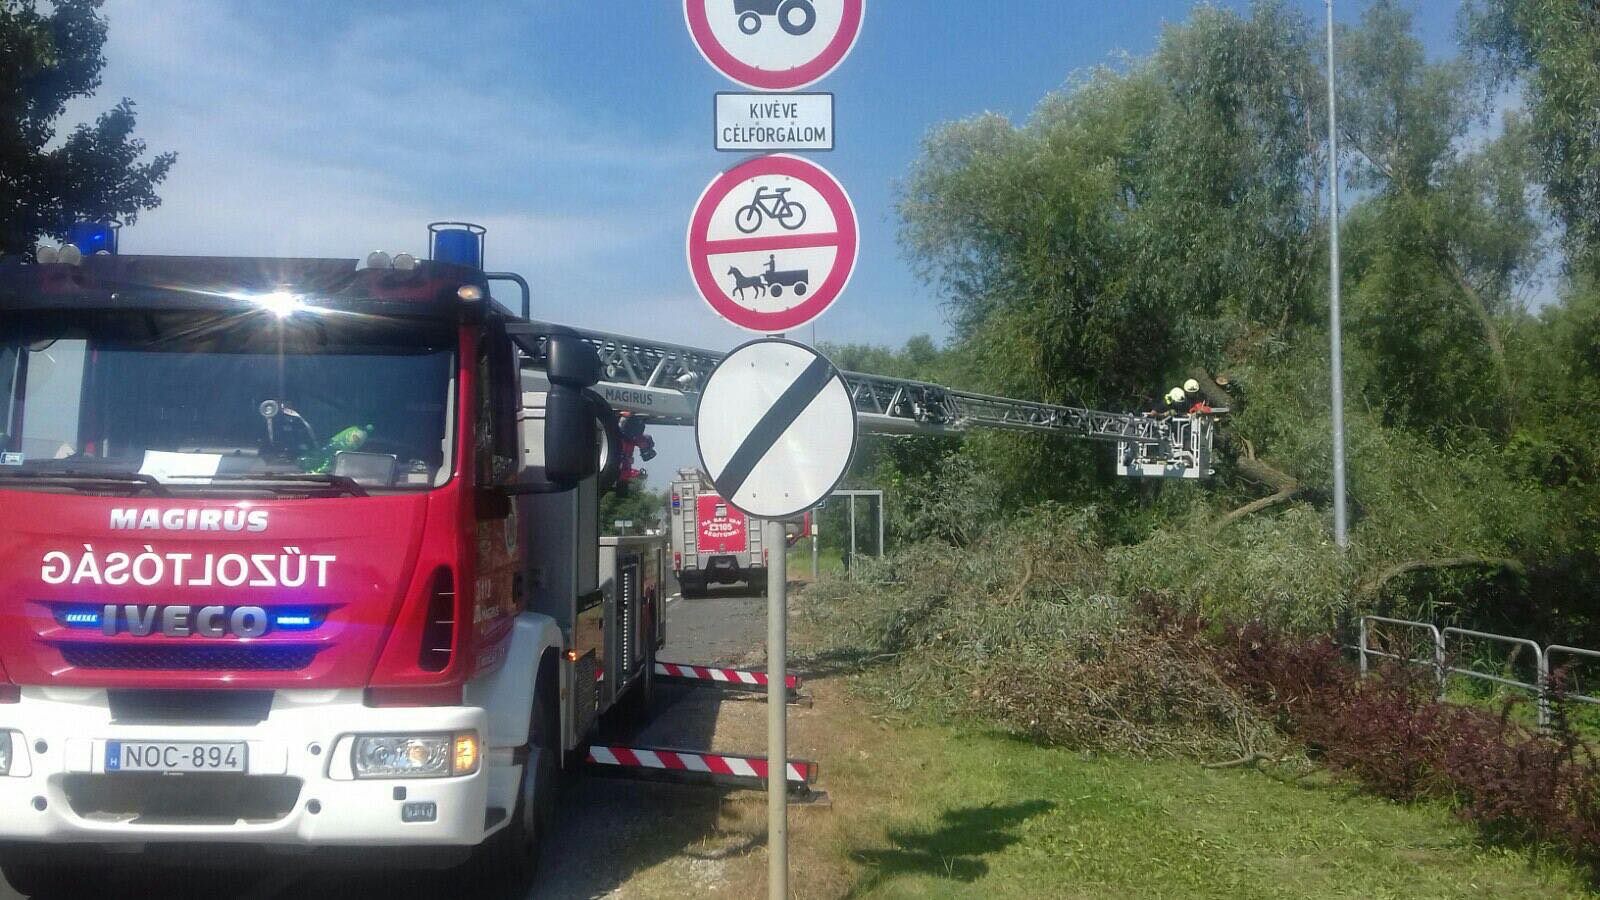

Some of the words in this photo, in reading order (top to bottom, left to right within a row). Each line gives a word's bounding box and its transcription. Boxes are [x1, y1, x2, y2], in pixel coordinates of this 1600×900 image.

[750, 100, 798, 119] KIVÉVE
[723, 123, 826, 143] CÉLFORGALOM
[605, 388, 653, 405] MAGIRUS
[109, 508, 269, 532] MAGIRUS
[103, 604, 268, 638] IVECO
[110, 757, 118, 766] H
[125, 745, 238, 768] NOC-894
